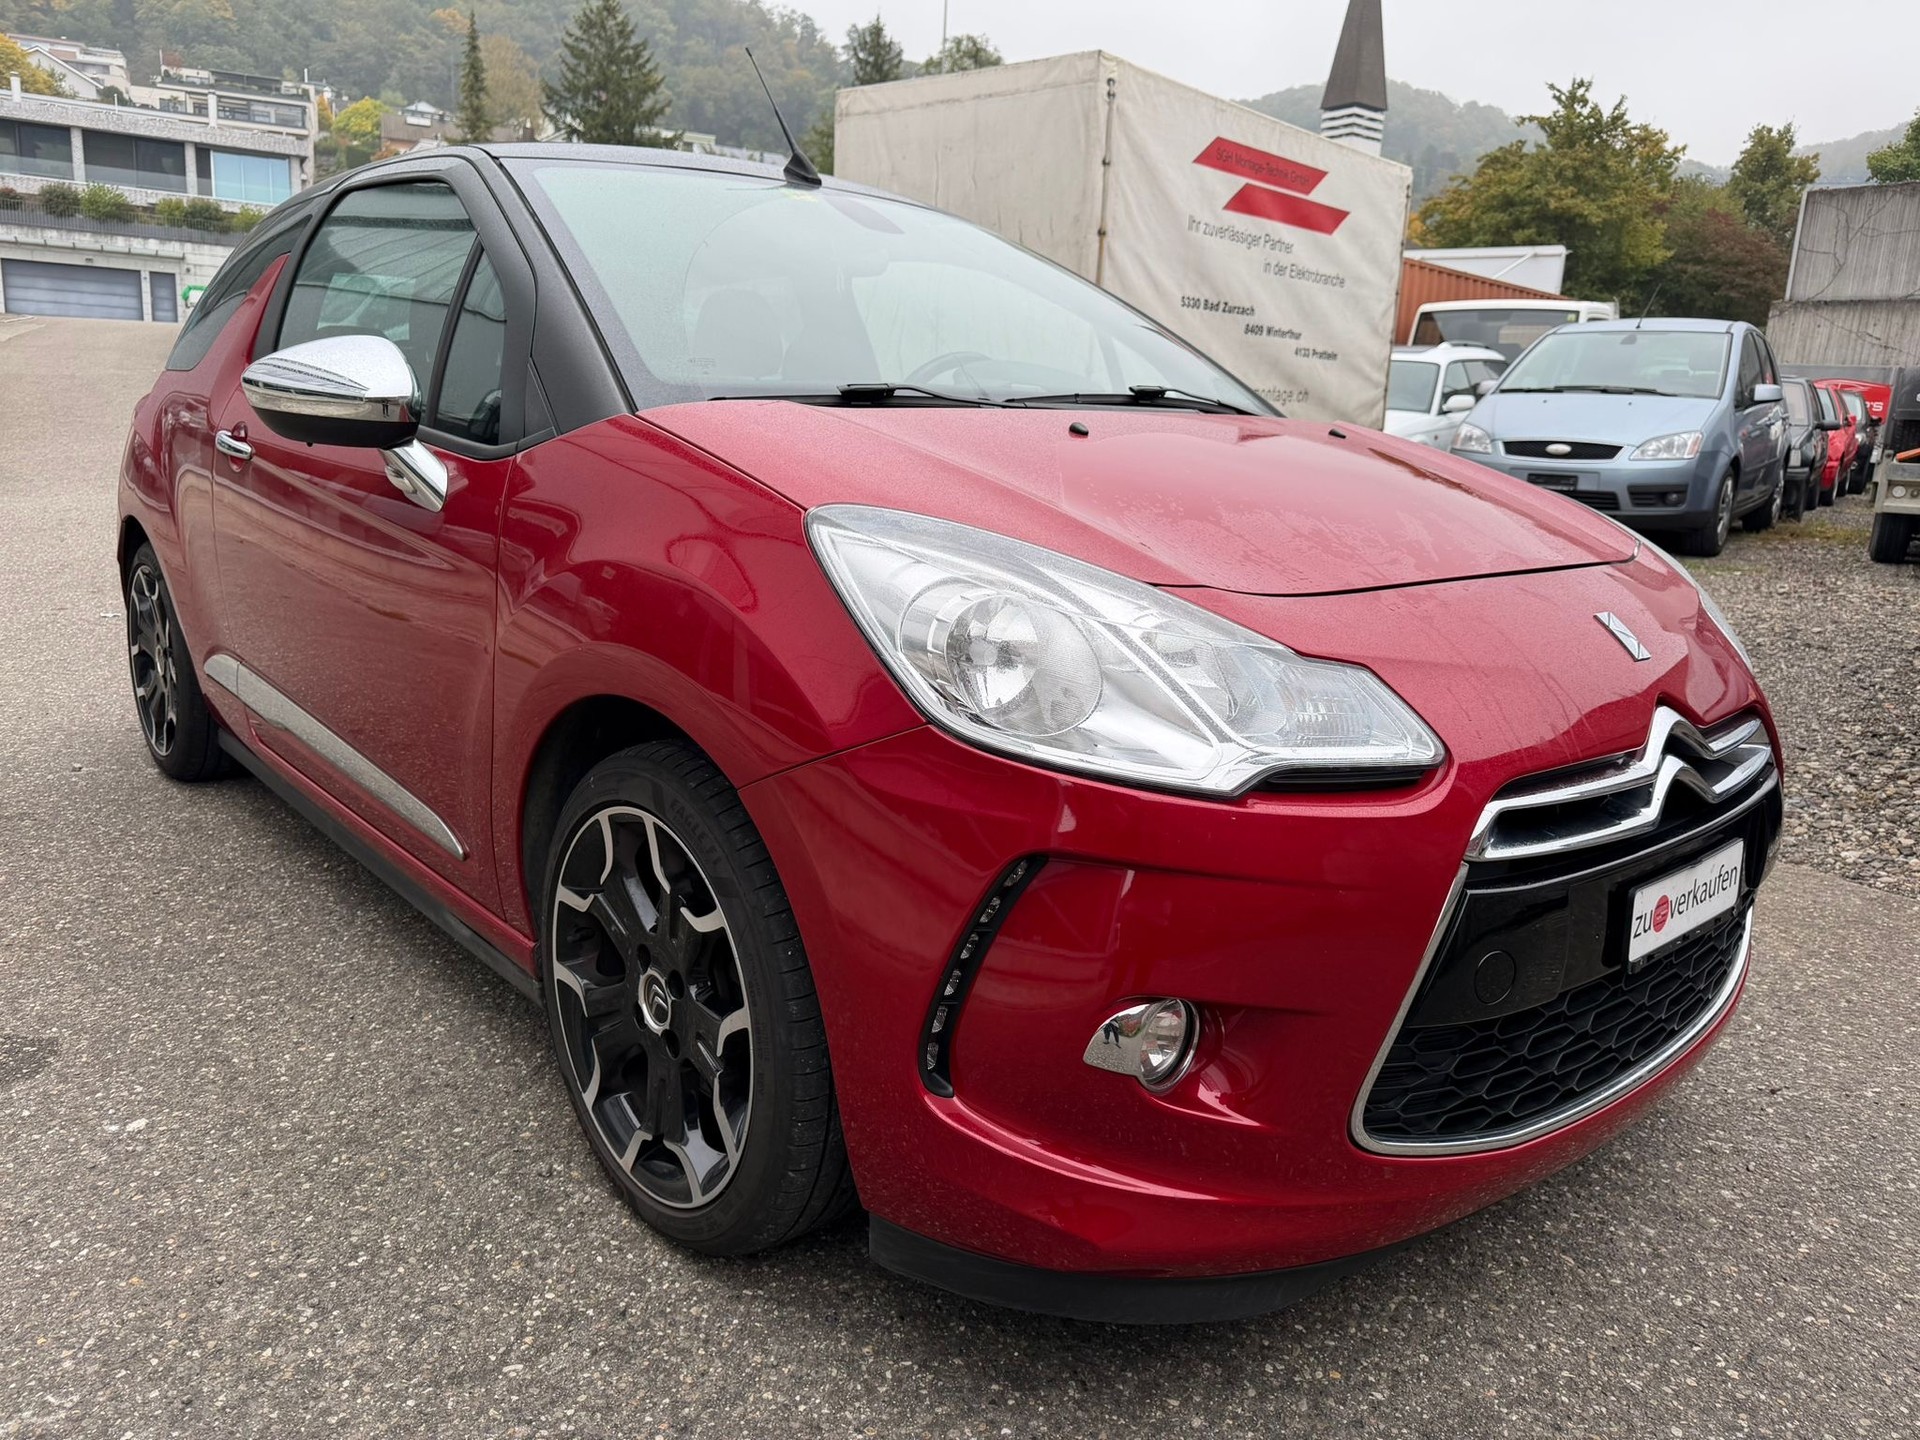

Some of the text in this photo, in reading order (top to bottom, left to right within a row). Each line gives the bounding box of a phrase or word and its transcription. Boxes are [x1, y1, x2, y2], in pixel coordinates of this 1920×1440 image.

[1187, 214, 1295, 254] Ihr zuverlässiger Partner
[1263, 258, 1346, 288] in der Elektrobranche
[1181, 296, 1255, 316] 5330 Bad Zurzach
[1244, 323, 1302, 340] 8409 Winterthur
[1311, 348, 1338, 361] Pratteln
[1633, 909, 1653, 939] zu
[1669, 864, 1738, 919] verkaufen
